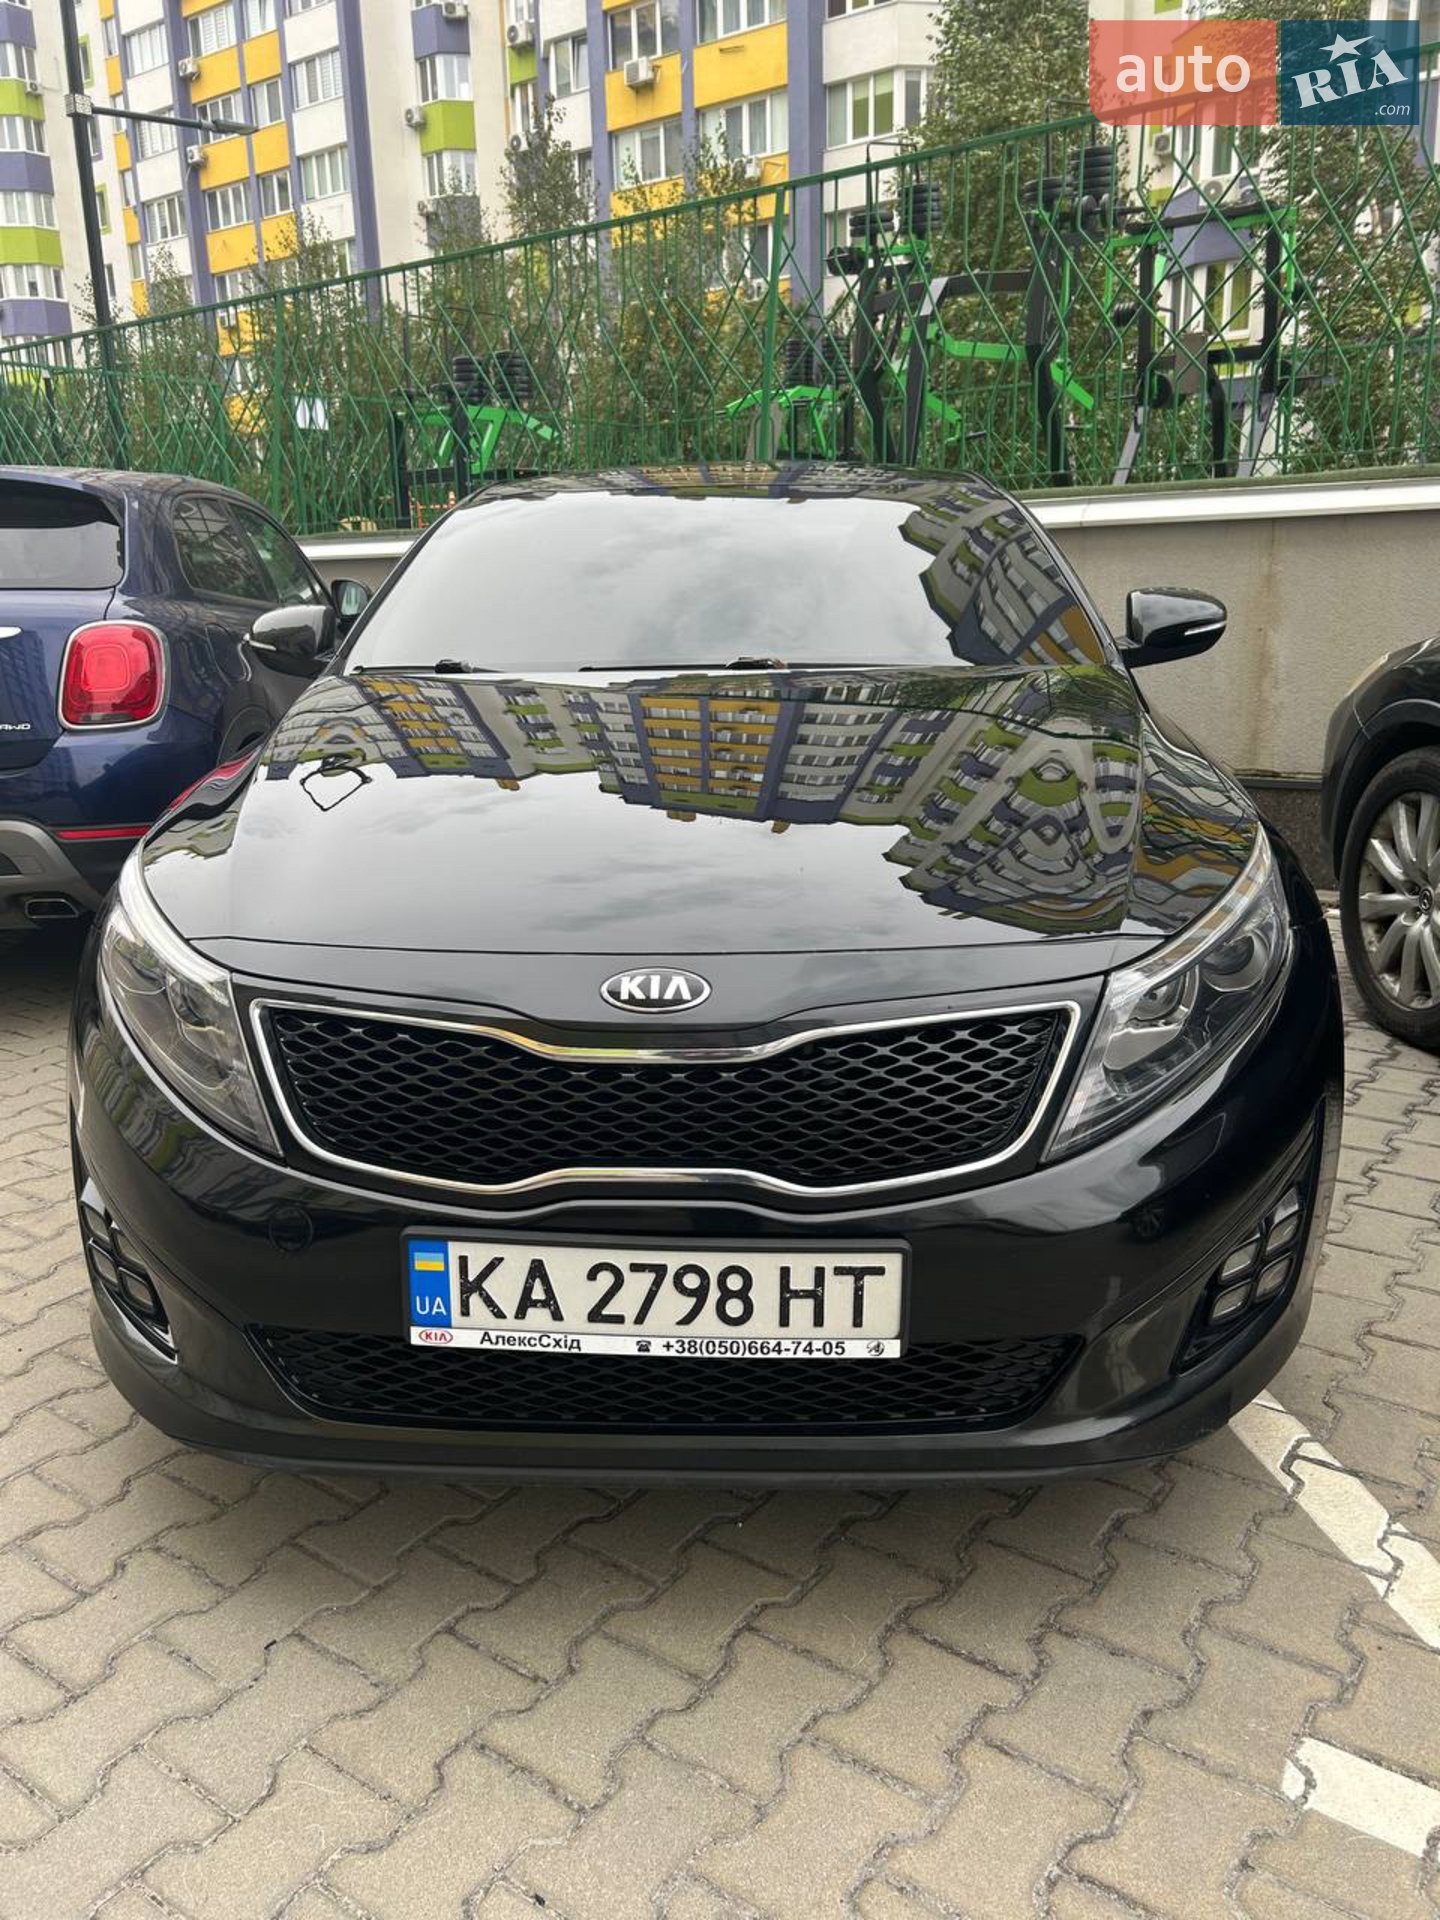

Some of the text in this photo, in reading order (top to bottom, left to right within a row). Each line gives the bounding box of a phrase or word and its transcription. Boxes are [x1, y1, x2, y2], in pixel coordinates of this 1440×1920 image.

[619, 974, 692, 1001] KIA
[458, 1255, 886, 1328] KA 2798 HT
[415, 1296, 447, 1316] UA
[424, 1331, 448, 1342] KIA
[480, 1331, 846, 1356] АлексСхід +38(050)664-74-05
